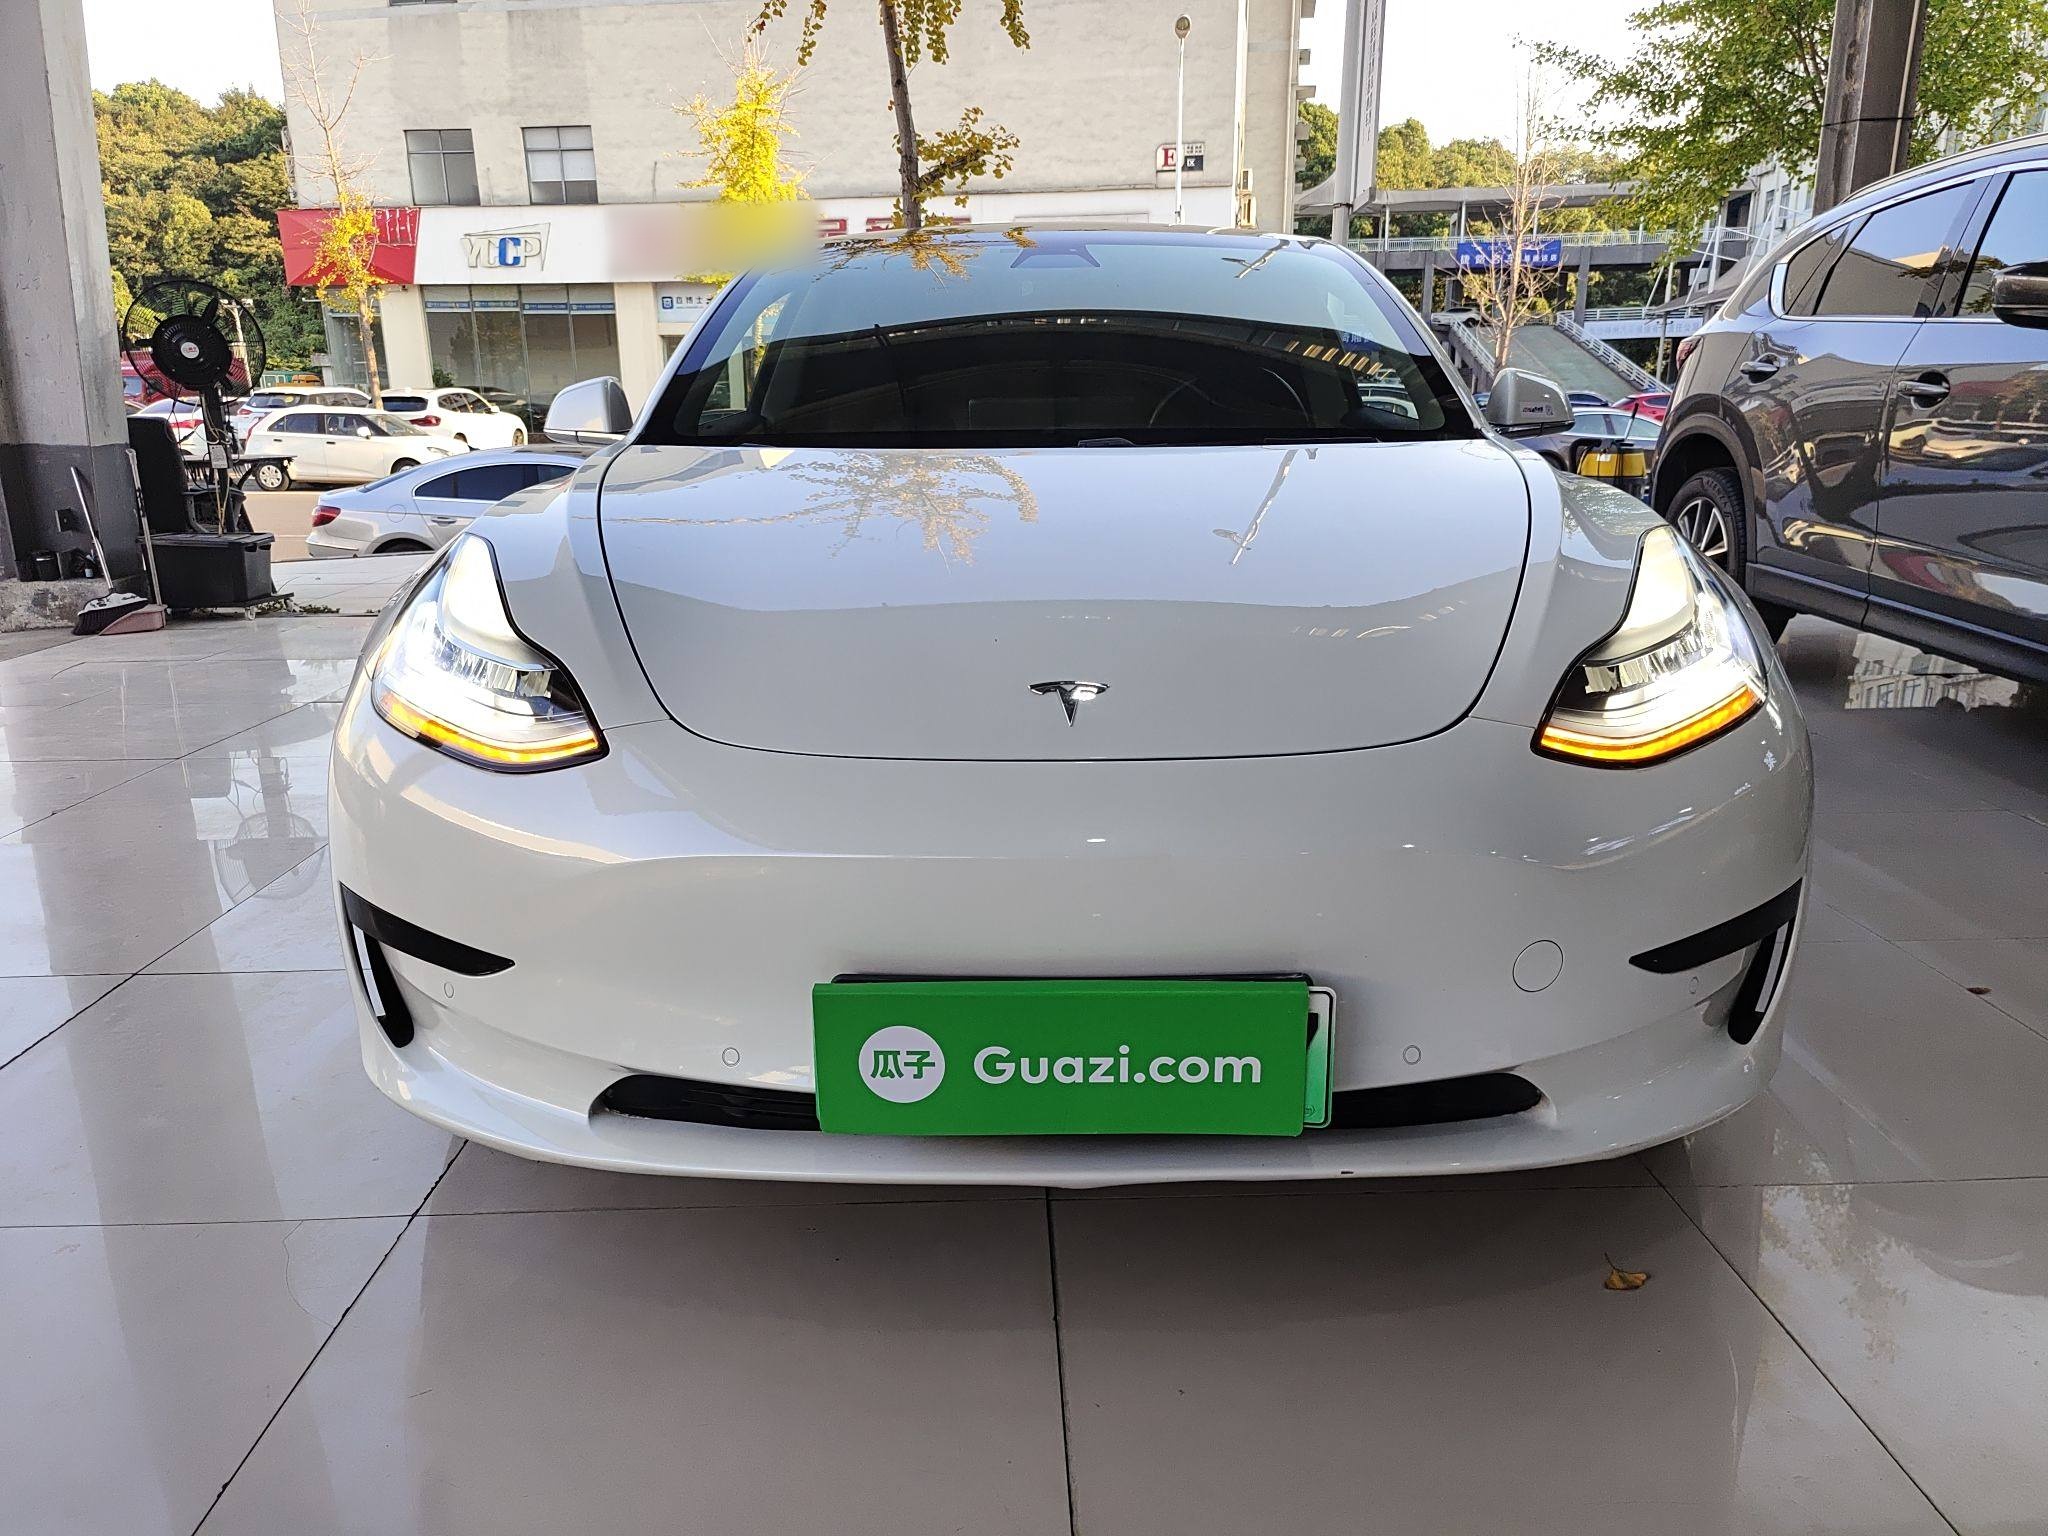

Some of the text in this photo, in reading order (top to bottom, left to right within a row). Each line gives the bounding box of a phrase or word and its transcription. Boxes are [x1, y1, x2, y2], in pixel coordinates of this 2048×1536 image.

[1162, 147, 1177, 168] E
[870, 1050, 936, 1080] 瓜子
[973, 1044, 1263, 1085] Guazi.com
